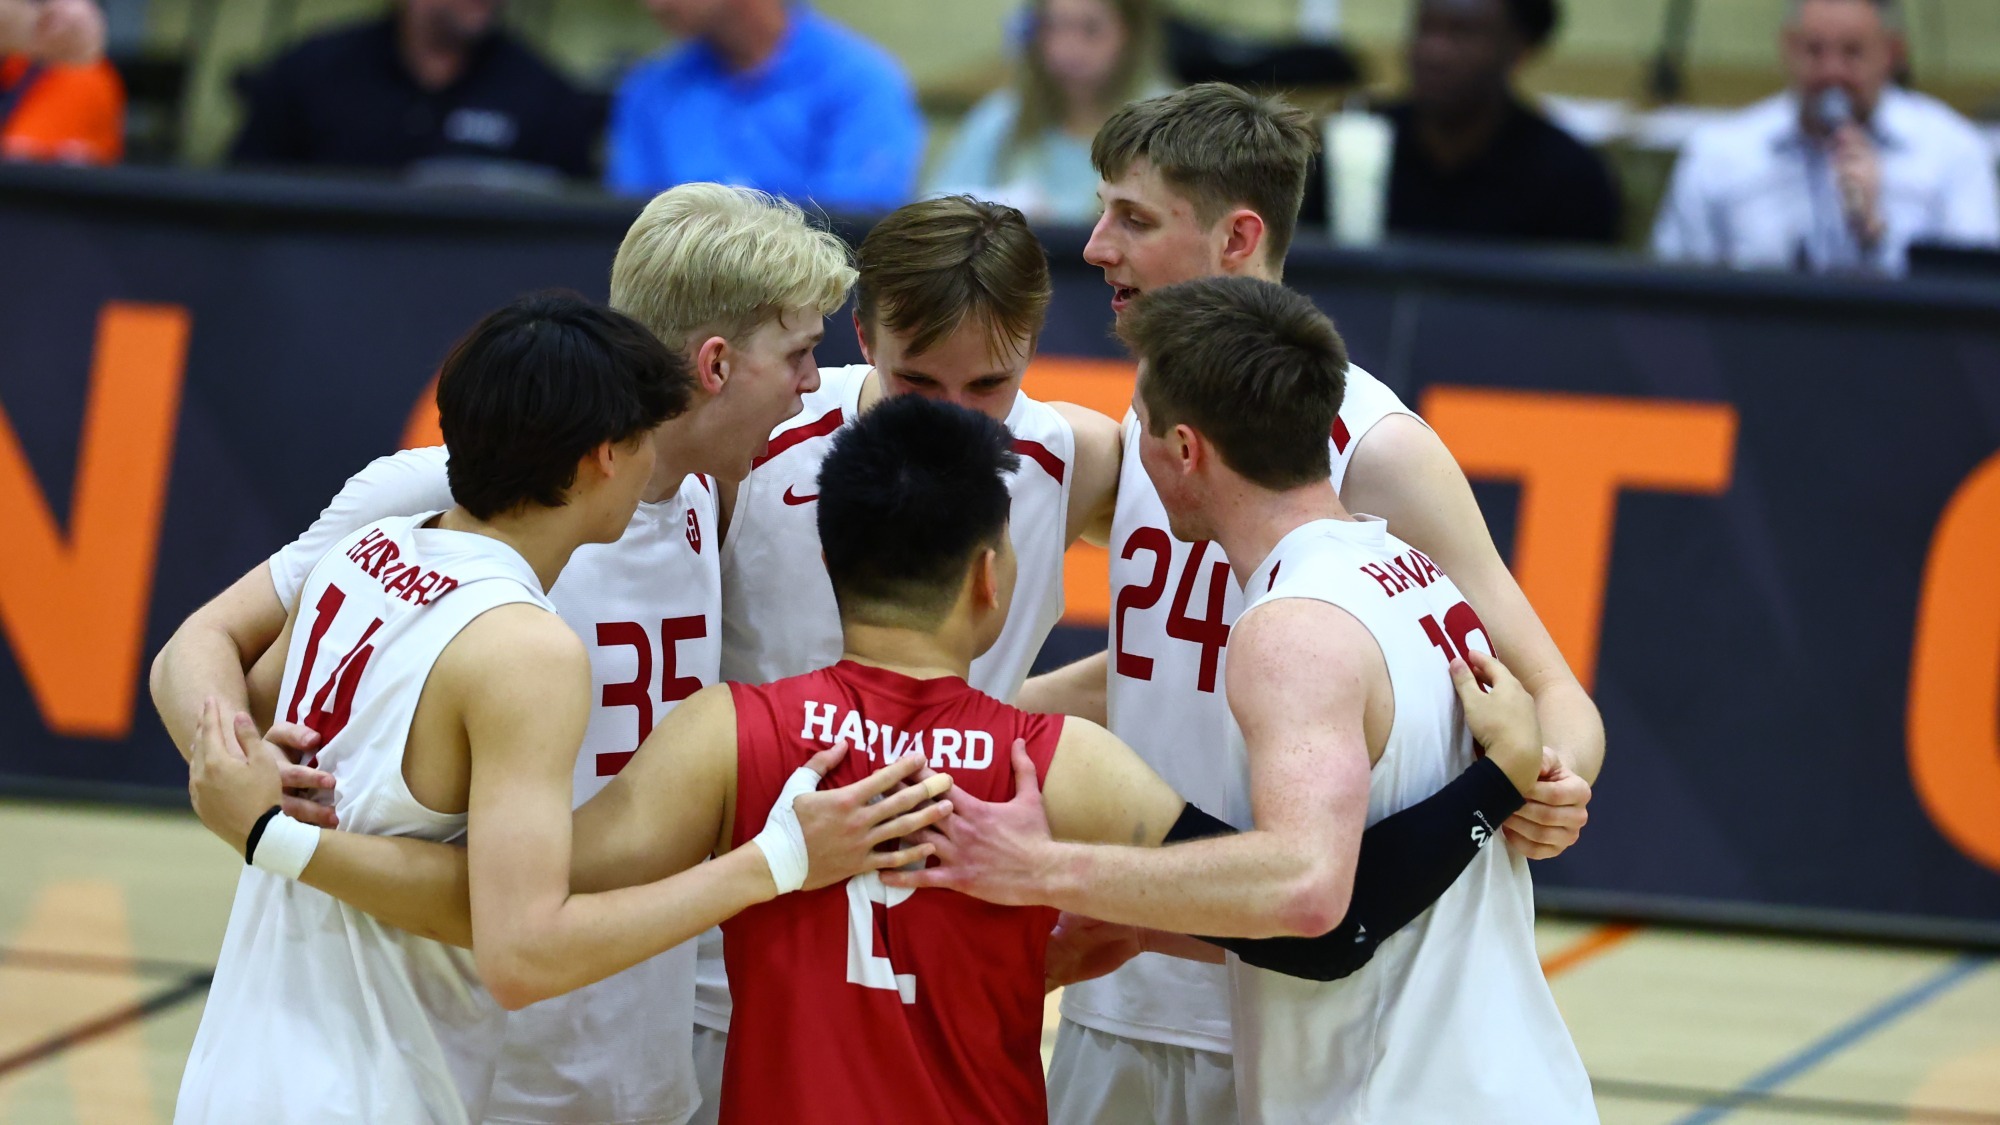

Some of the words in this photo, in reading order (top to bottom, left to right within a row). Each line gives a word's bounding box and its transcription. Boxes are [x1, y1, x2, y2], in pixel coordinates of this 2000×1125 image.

[286, 582, 384, 768] 14
[1116, 526, 1231, 693] 24
[596, 614, 707, 777] 35
[801, 700, 994, 770] HARVARD
